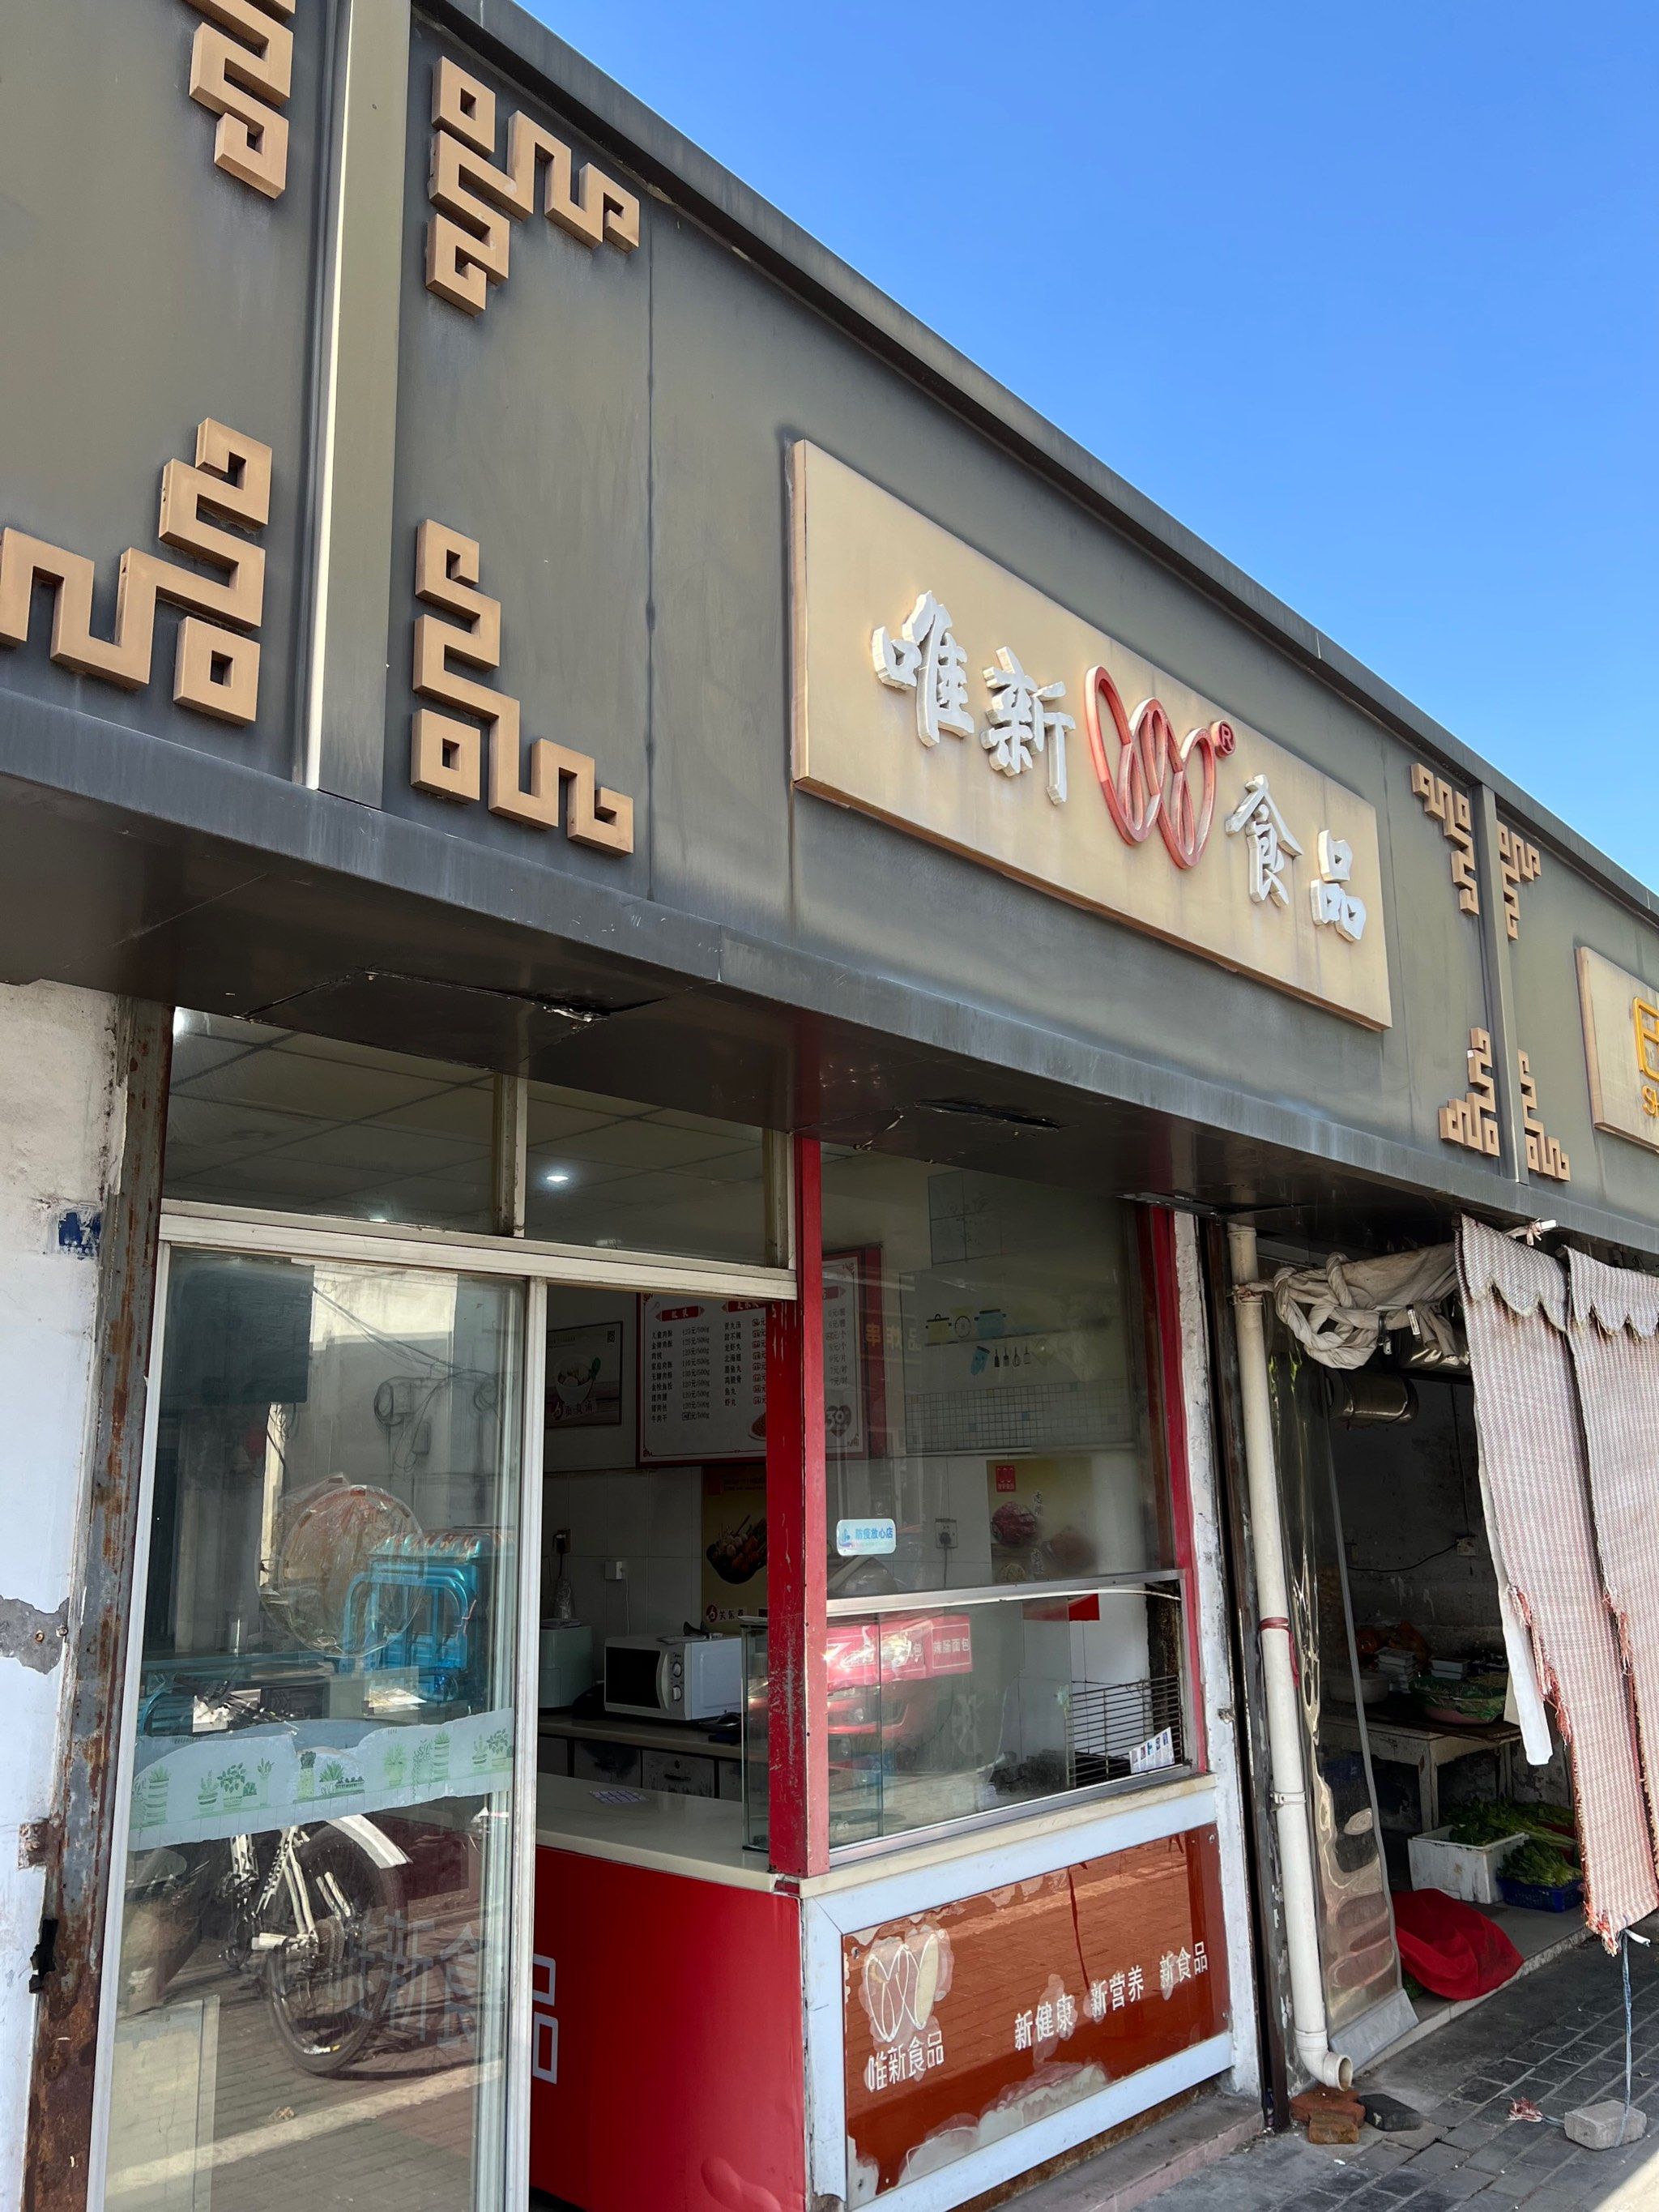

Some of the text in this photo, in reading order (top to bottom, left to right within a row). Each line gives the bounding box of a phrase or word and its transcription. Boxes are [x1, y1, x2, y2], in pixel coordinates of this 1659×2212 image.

[872, 590, 1076, 805] 唯新
[1226, 774, 1367, 942] 食品
[855, 1527, 893, 1539] 防疫放心店
[1014, 1941, 1208, 2051] 新健康 新营养 新食品
[868, 2030, 945, 2092] 唯新食品
